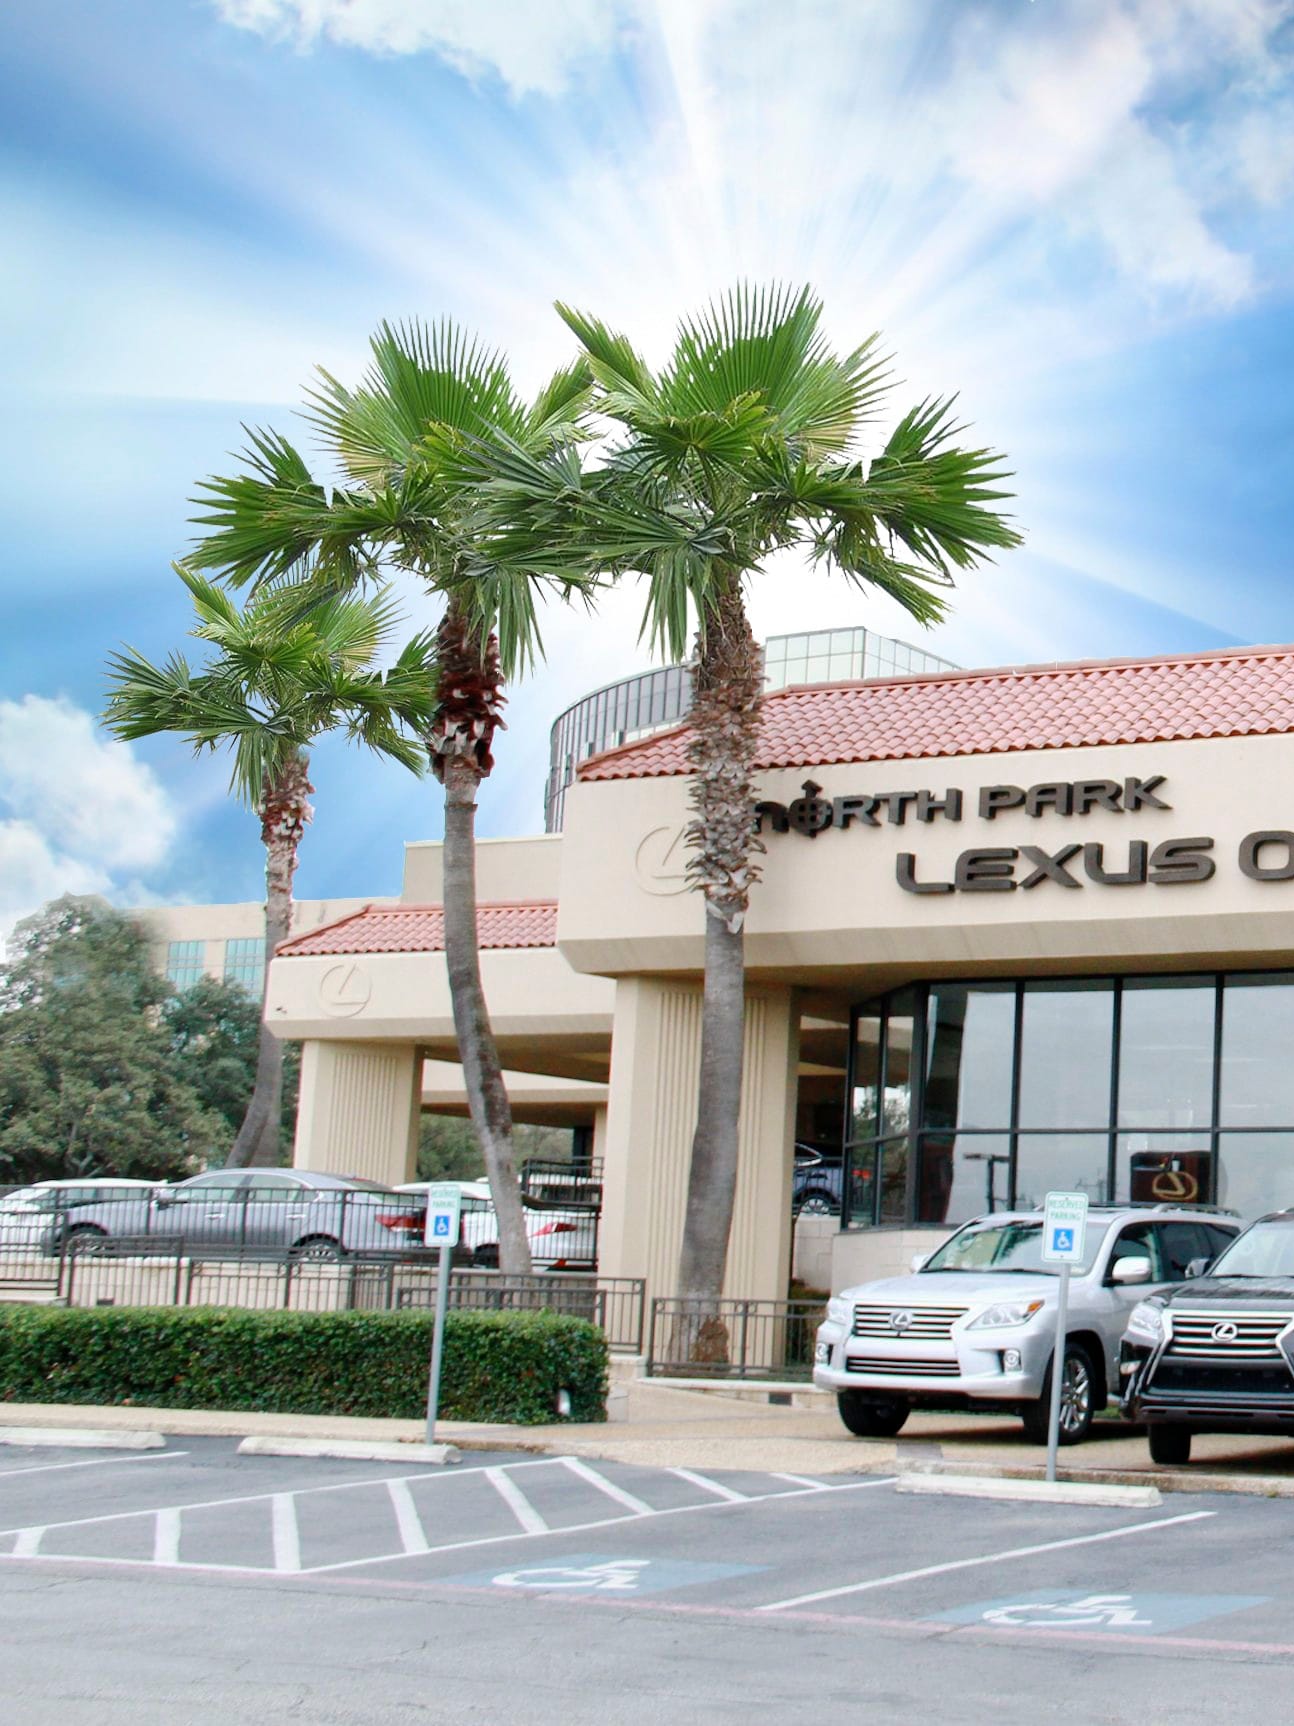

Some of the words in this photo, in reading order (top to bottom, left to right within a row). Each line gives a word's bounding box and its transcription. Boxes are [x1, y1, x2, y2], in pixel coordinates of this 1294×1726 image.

[979, 776, 1173, 820] PARK
[896, 837, 1216, 894] LEXUS
[1051, 1211, 1081, 1220] PARKING
